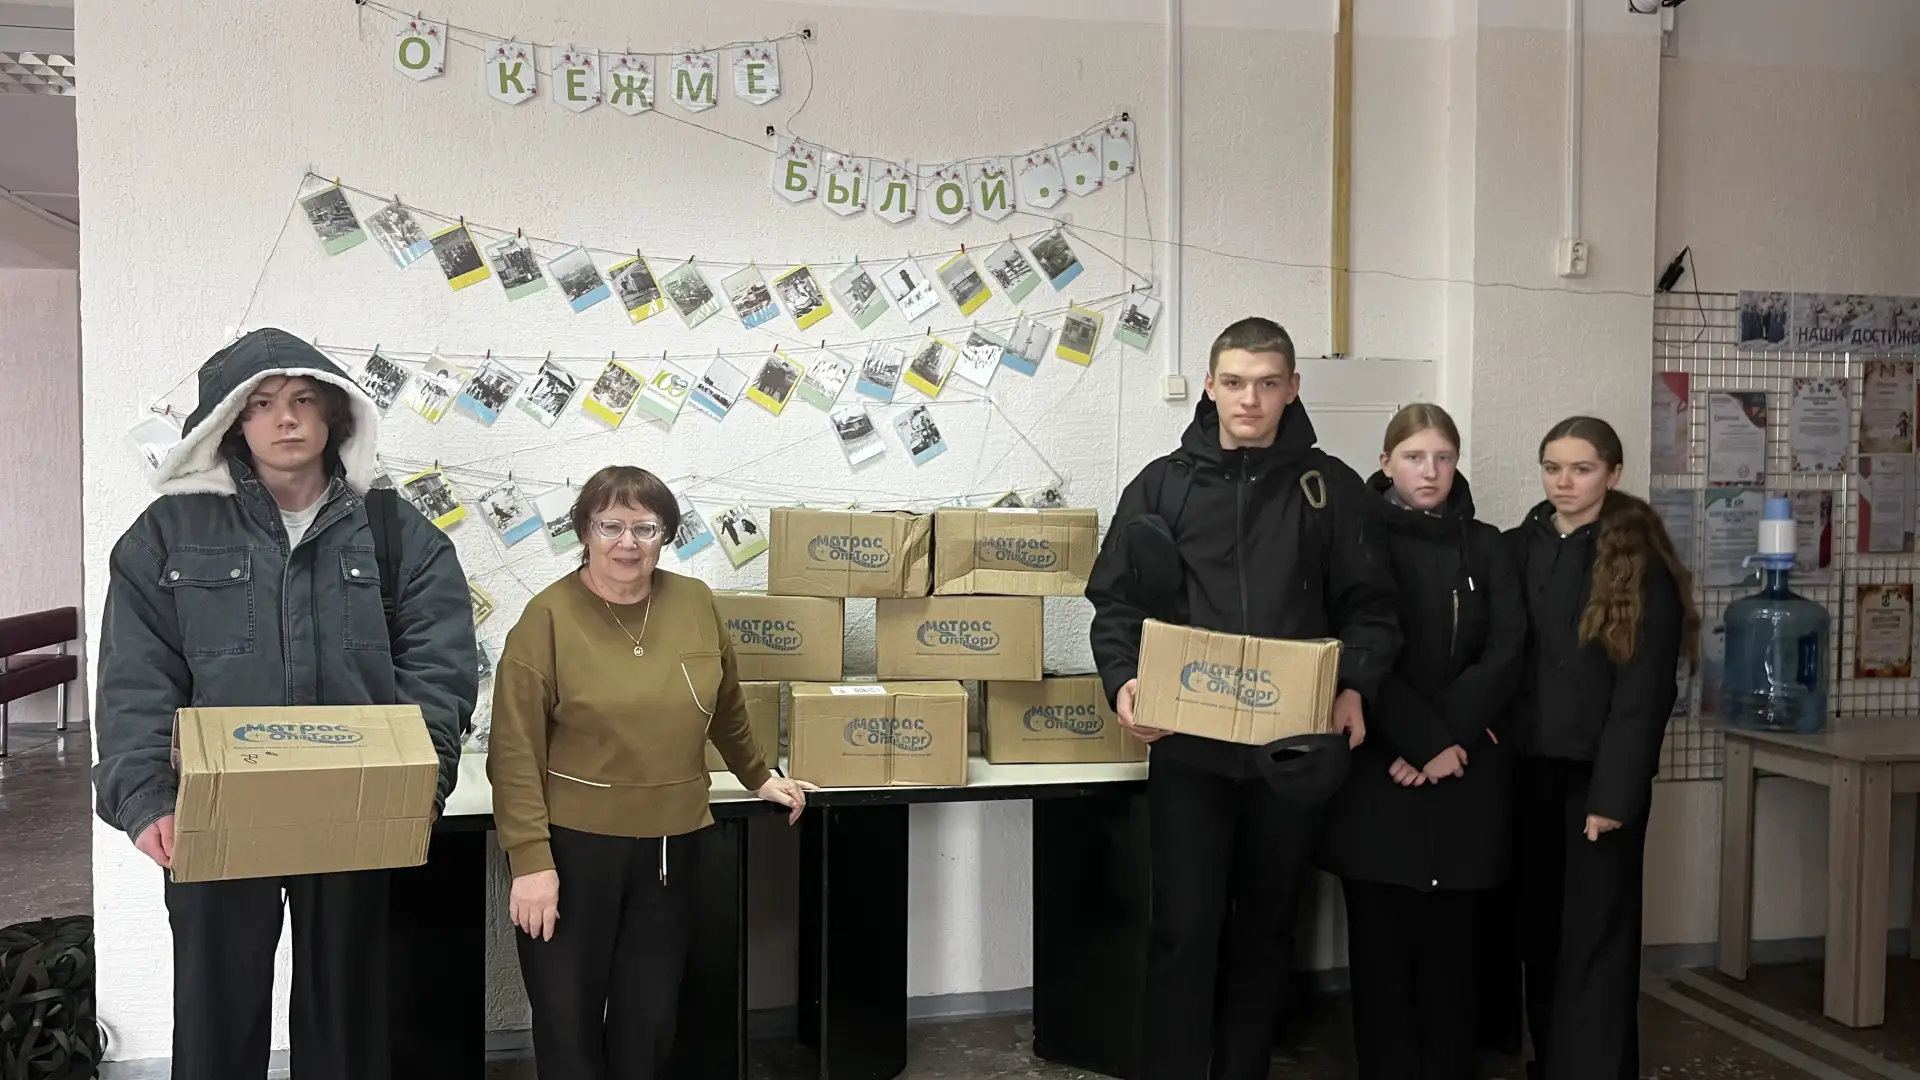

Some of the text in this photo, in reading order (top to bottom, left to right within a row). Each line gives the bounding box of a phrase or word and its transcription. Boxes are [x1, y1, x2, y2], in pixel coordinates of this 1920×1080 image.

[398, 36, 768, 108] О КЕЖМЕ
[1798, 327, 1920, 345] НАШИ ДОСТИЖЕ
